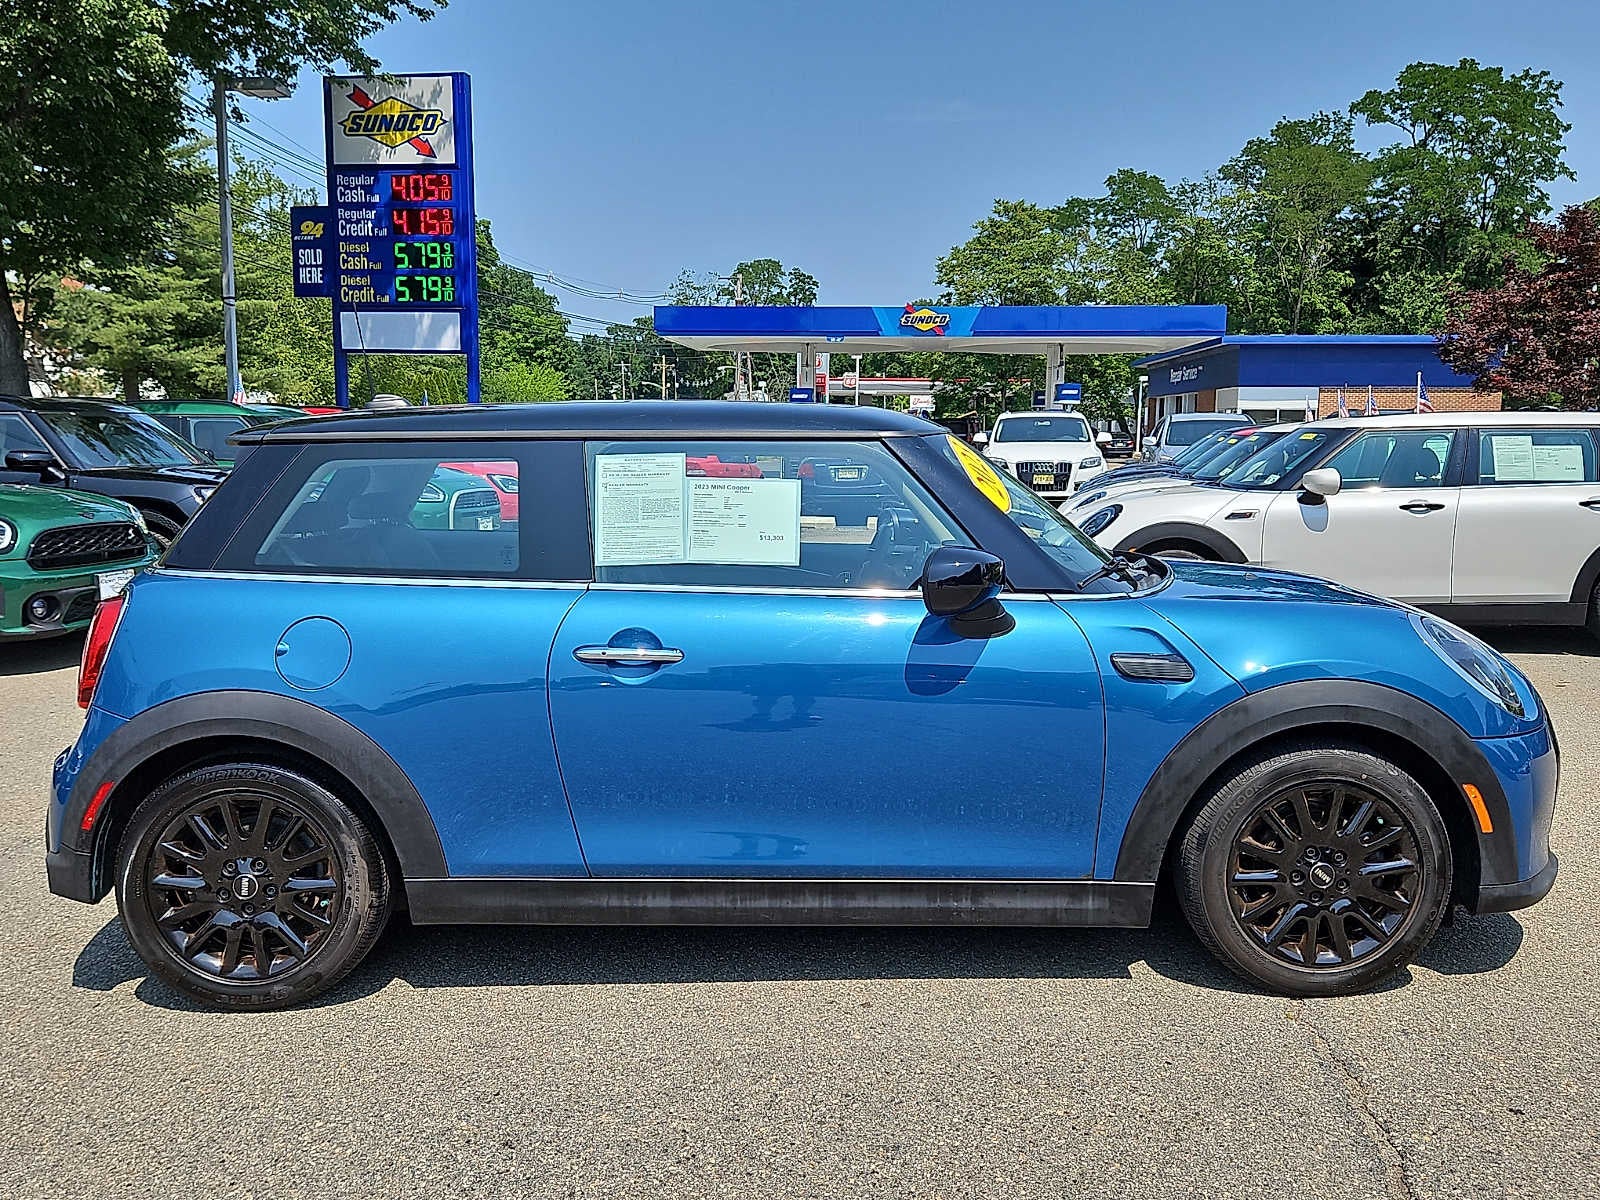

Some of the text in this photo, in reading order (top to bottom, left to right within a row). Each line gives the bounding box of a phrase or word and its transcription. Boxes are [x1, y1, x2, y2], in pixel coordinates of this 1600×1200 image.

[348, 113, 439, 133] SUNOCO
[336, 174, 375, 187] Regular
[392, 174, 439, 201] 4.05
[337, 187, 380, 203] Cash Full
[338, 208, 377, 221] Regular
[393, 208, 440, 235] 4.15
[300, 221, 324, 238] 94
[338, 220, 388, 236] Credit Full
[339, 241, 370, 253] Diesel
[394, 242, 441, 269] 5.79
[299, 249, 323, 265] SOLD
[340, 253, 382, 270] Cash Full
[299, 267, 323, 284] HERE
[340, 275, 371, 286] Diesel
[341, 286, 390, 303] Credit Full
[395, 276, 442, 302] 5.79
[902, 315, 948, 325] SUNOCO
[1314, 867, 1331, 883] MINI
[241, 877, 250, 896] MINI
